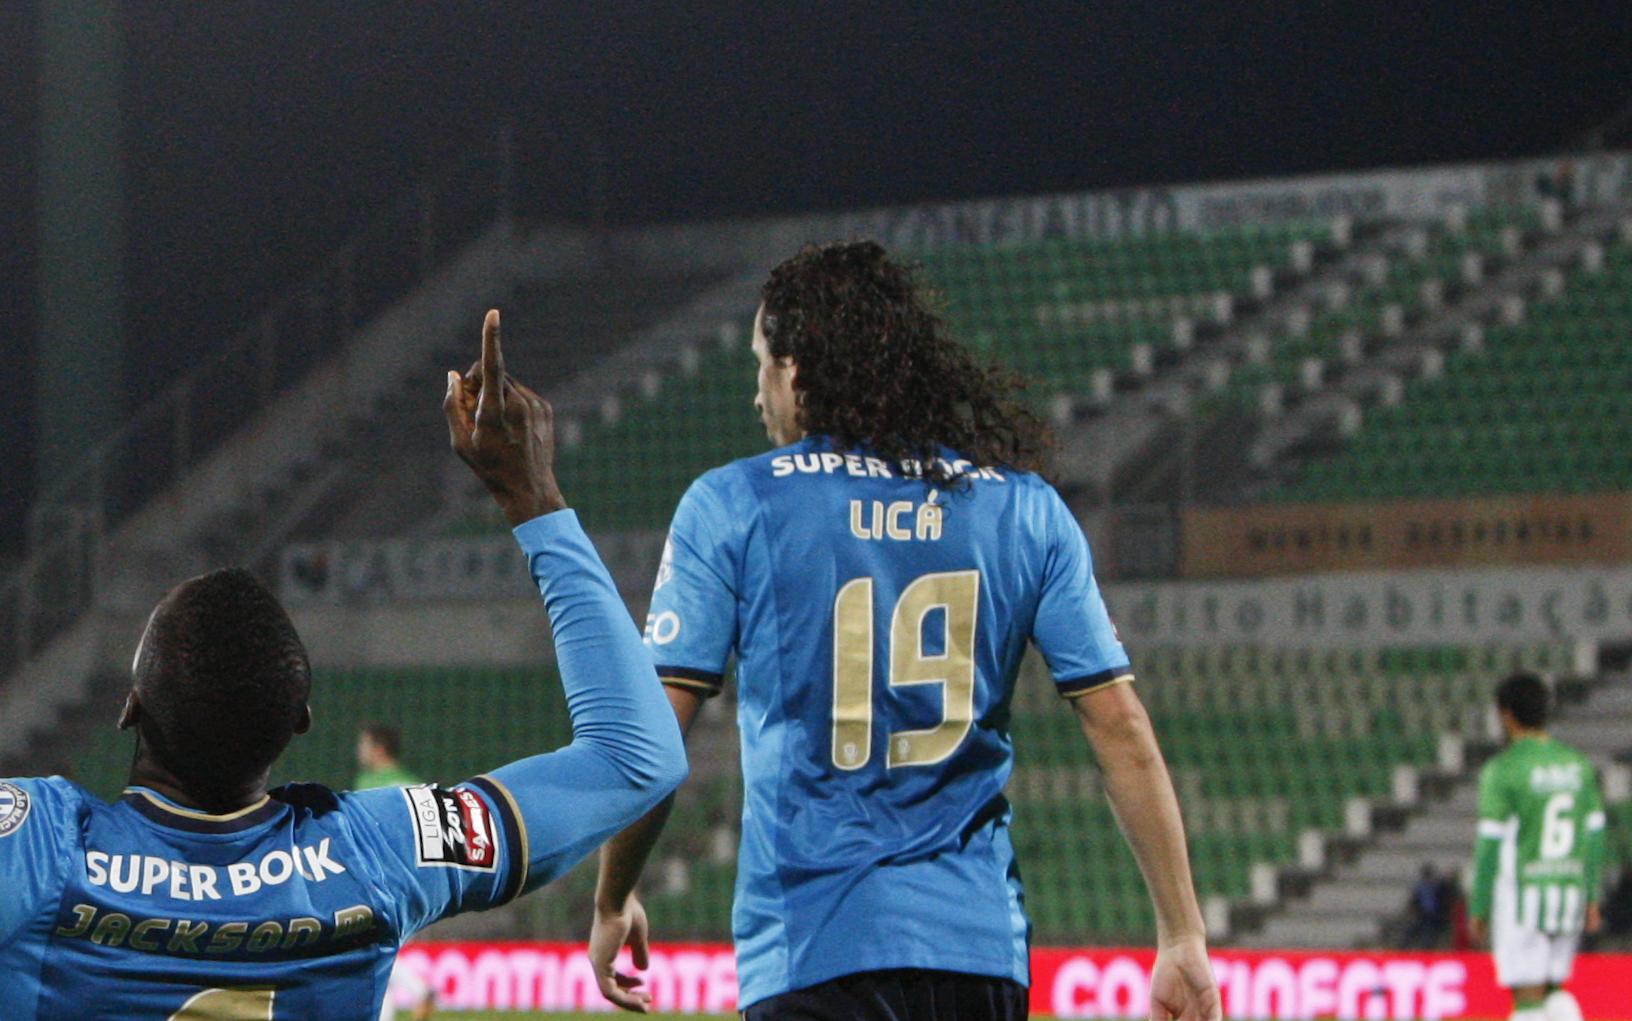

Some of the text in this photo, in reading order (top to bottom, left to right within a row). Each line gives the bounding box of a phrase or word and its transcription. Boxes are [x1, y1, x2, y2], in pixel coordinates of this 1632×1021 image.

[771, 453, 892, 479] SUPER
[849, 488, 943, 541] LICÁ
[831, 569, 980, 771] 19
[419, 798, 440, 839] LIGA
[1540, 793, 1576, 860] 6
[86, 850, 222, 901] SUPER
[56, 903, 322, 952] JACKSON
